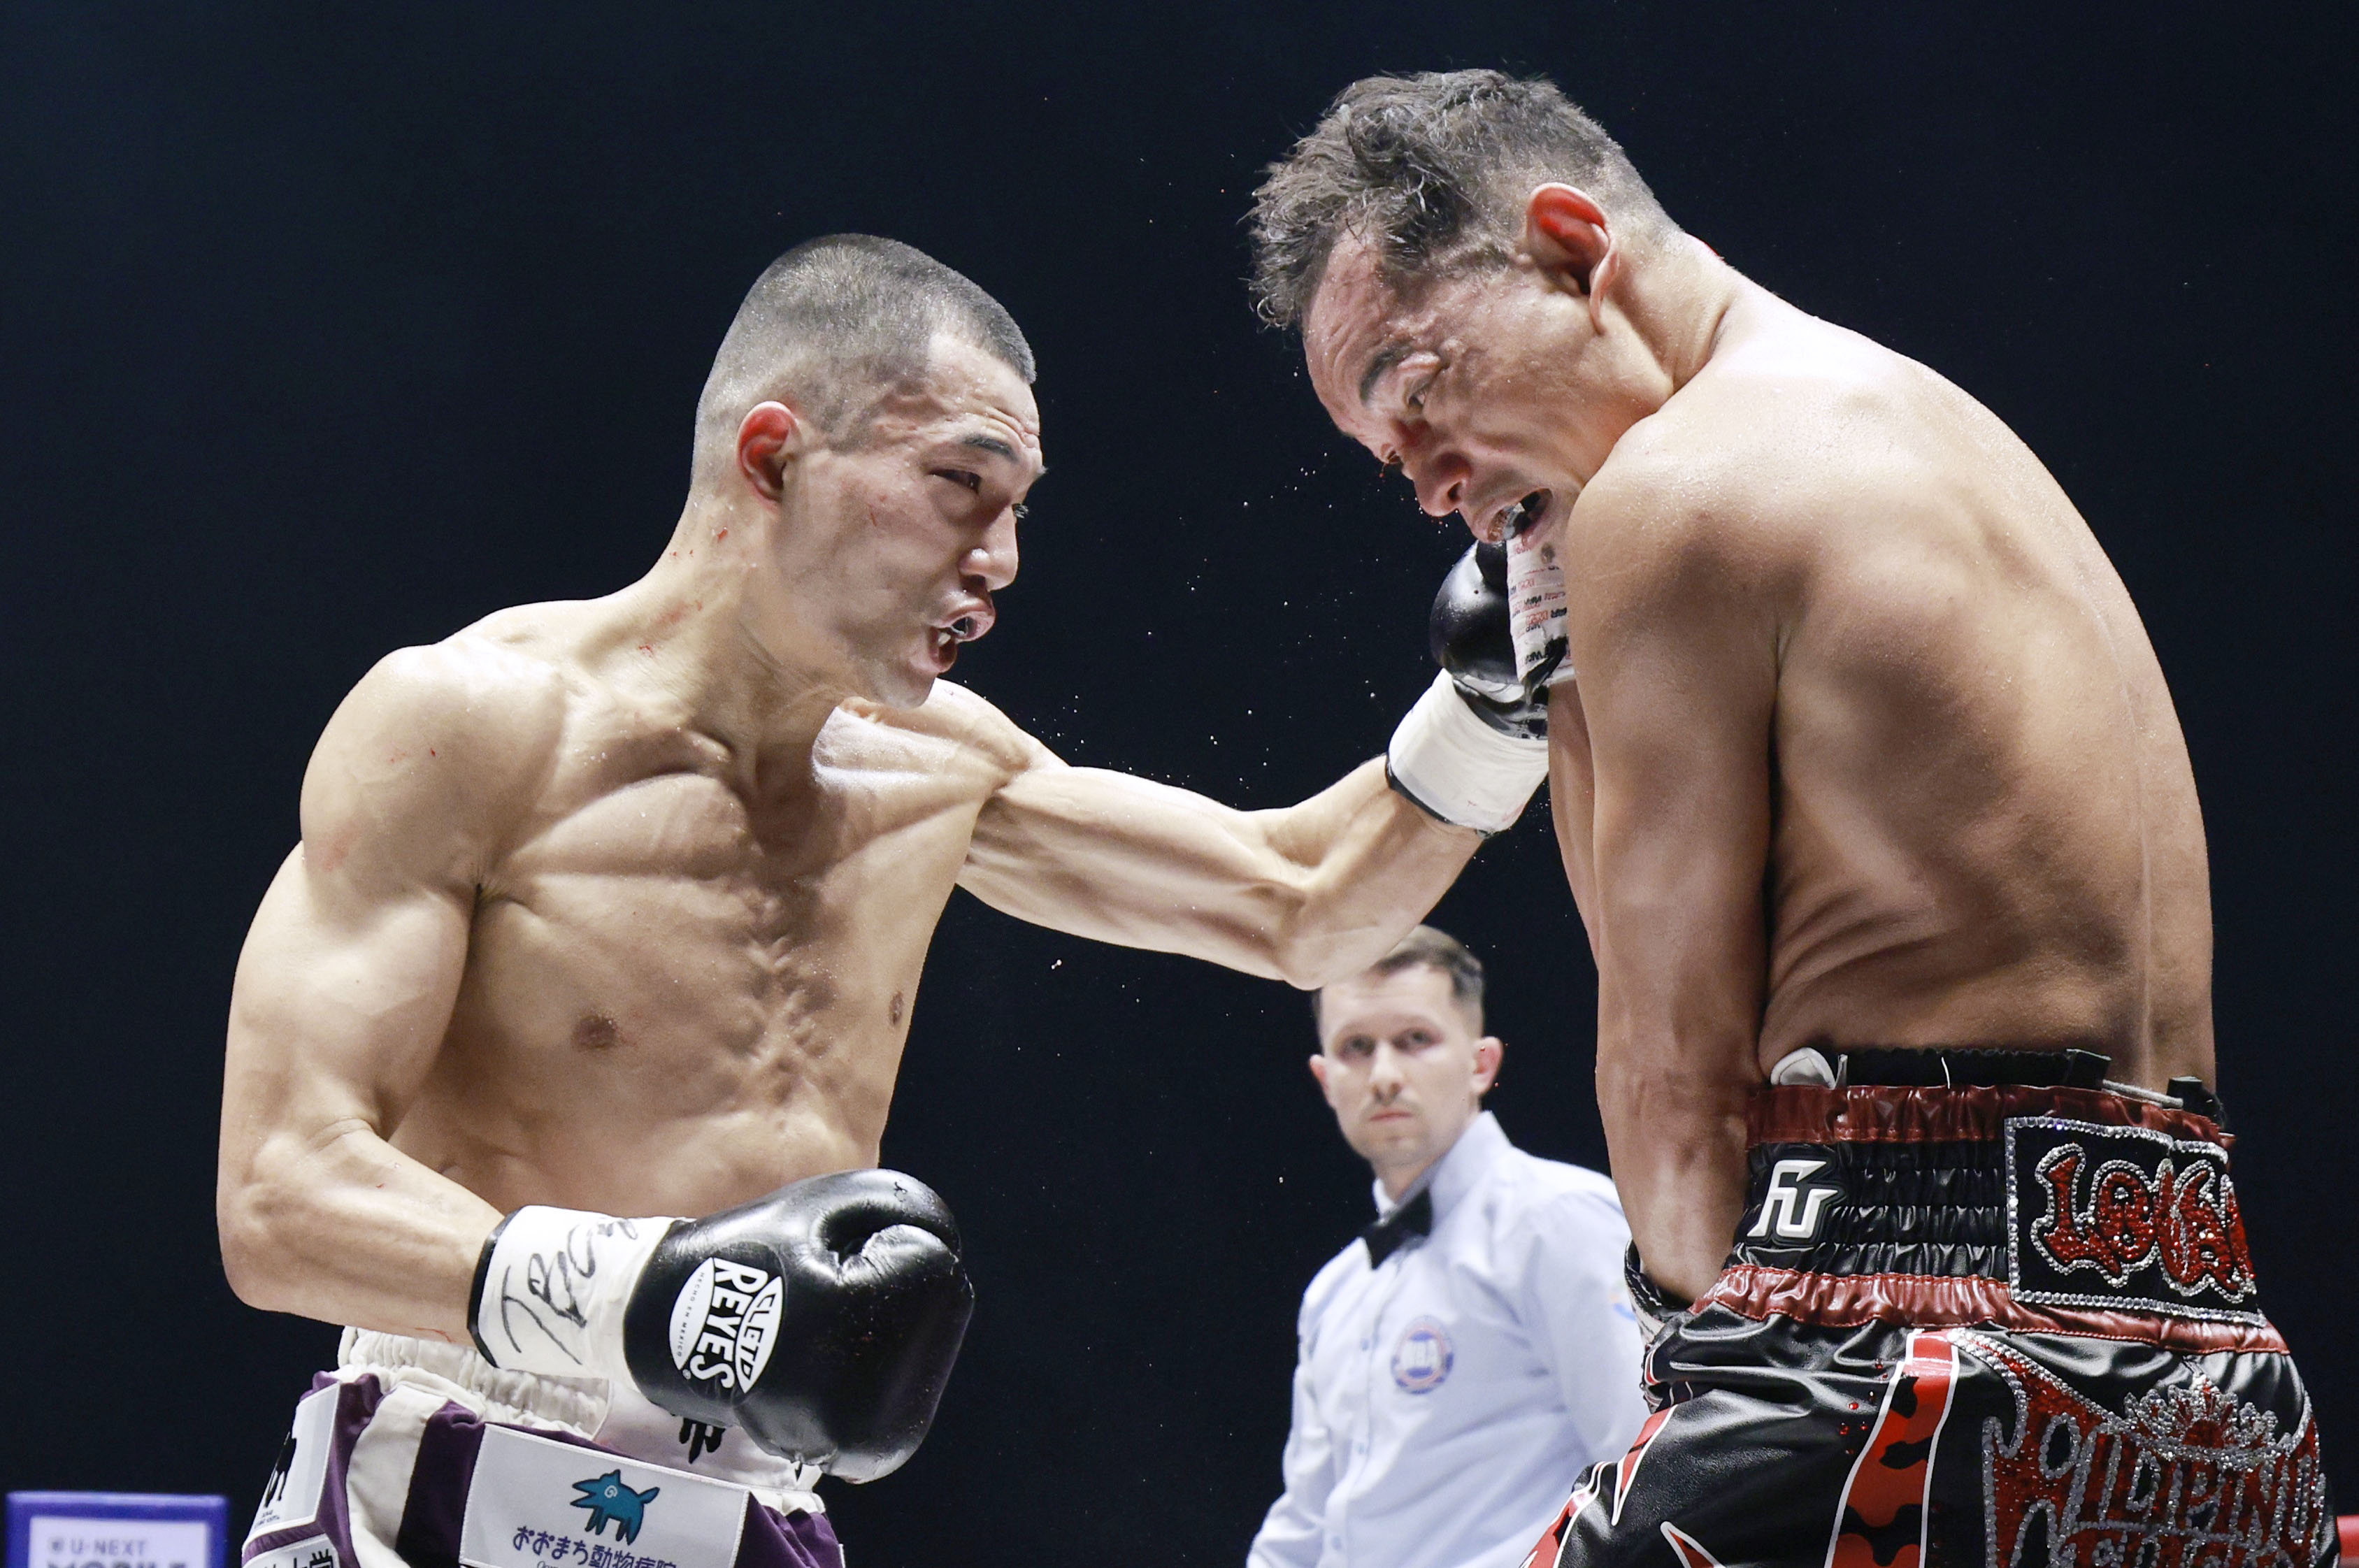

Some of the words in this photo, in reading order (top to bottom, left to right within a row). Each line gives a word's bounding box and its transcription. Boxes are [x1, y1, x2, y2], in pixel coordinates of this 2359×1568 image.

[689, 1272, 705, 1302] HECHO
[684, 1306, 693, 1319] EN
[689, 1257, 769, 1388] REYES
[677, 1322, 688, 1358] MEXICO
[740, 1293, 777, 1381] CLETO
